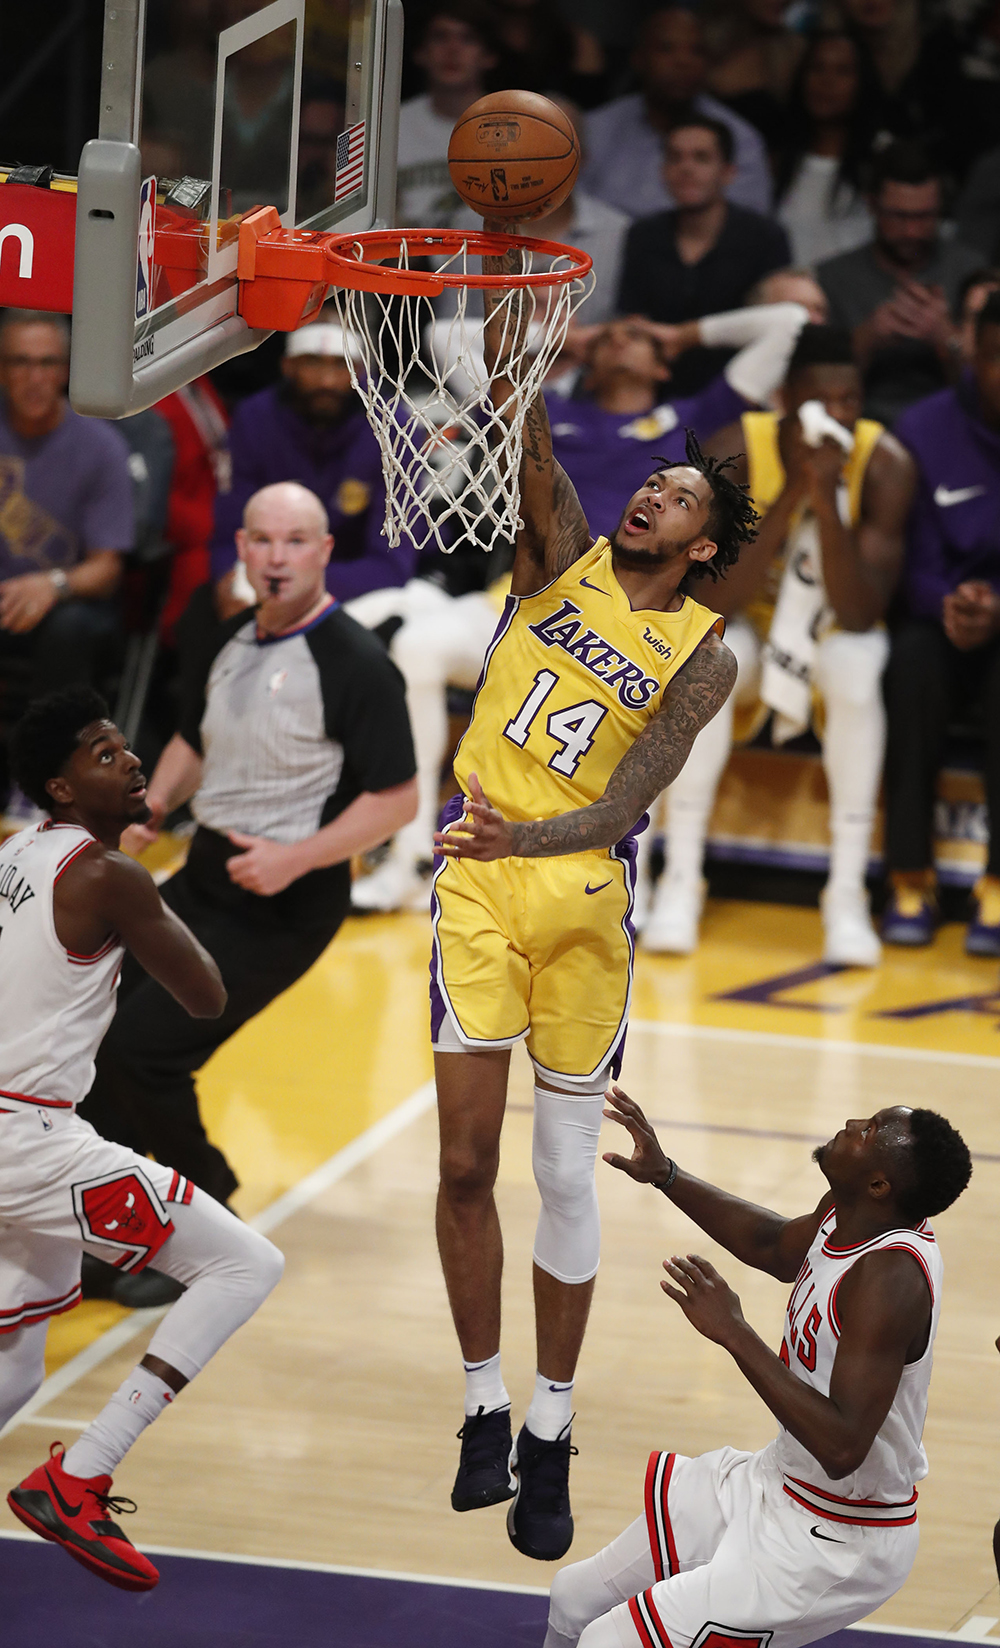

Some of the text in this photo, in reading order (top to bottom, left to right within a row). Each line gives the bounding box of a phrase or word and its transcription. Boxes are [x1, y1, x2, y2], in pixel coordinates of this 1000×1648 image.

[527, 598, 660, 711] LAKERS
[642, 626, 672, 660] wish
[502, 668, 609, 779] 14
